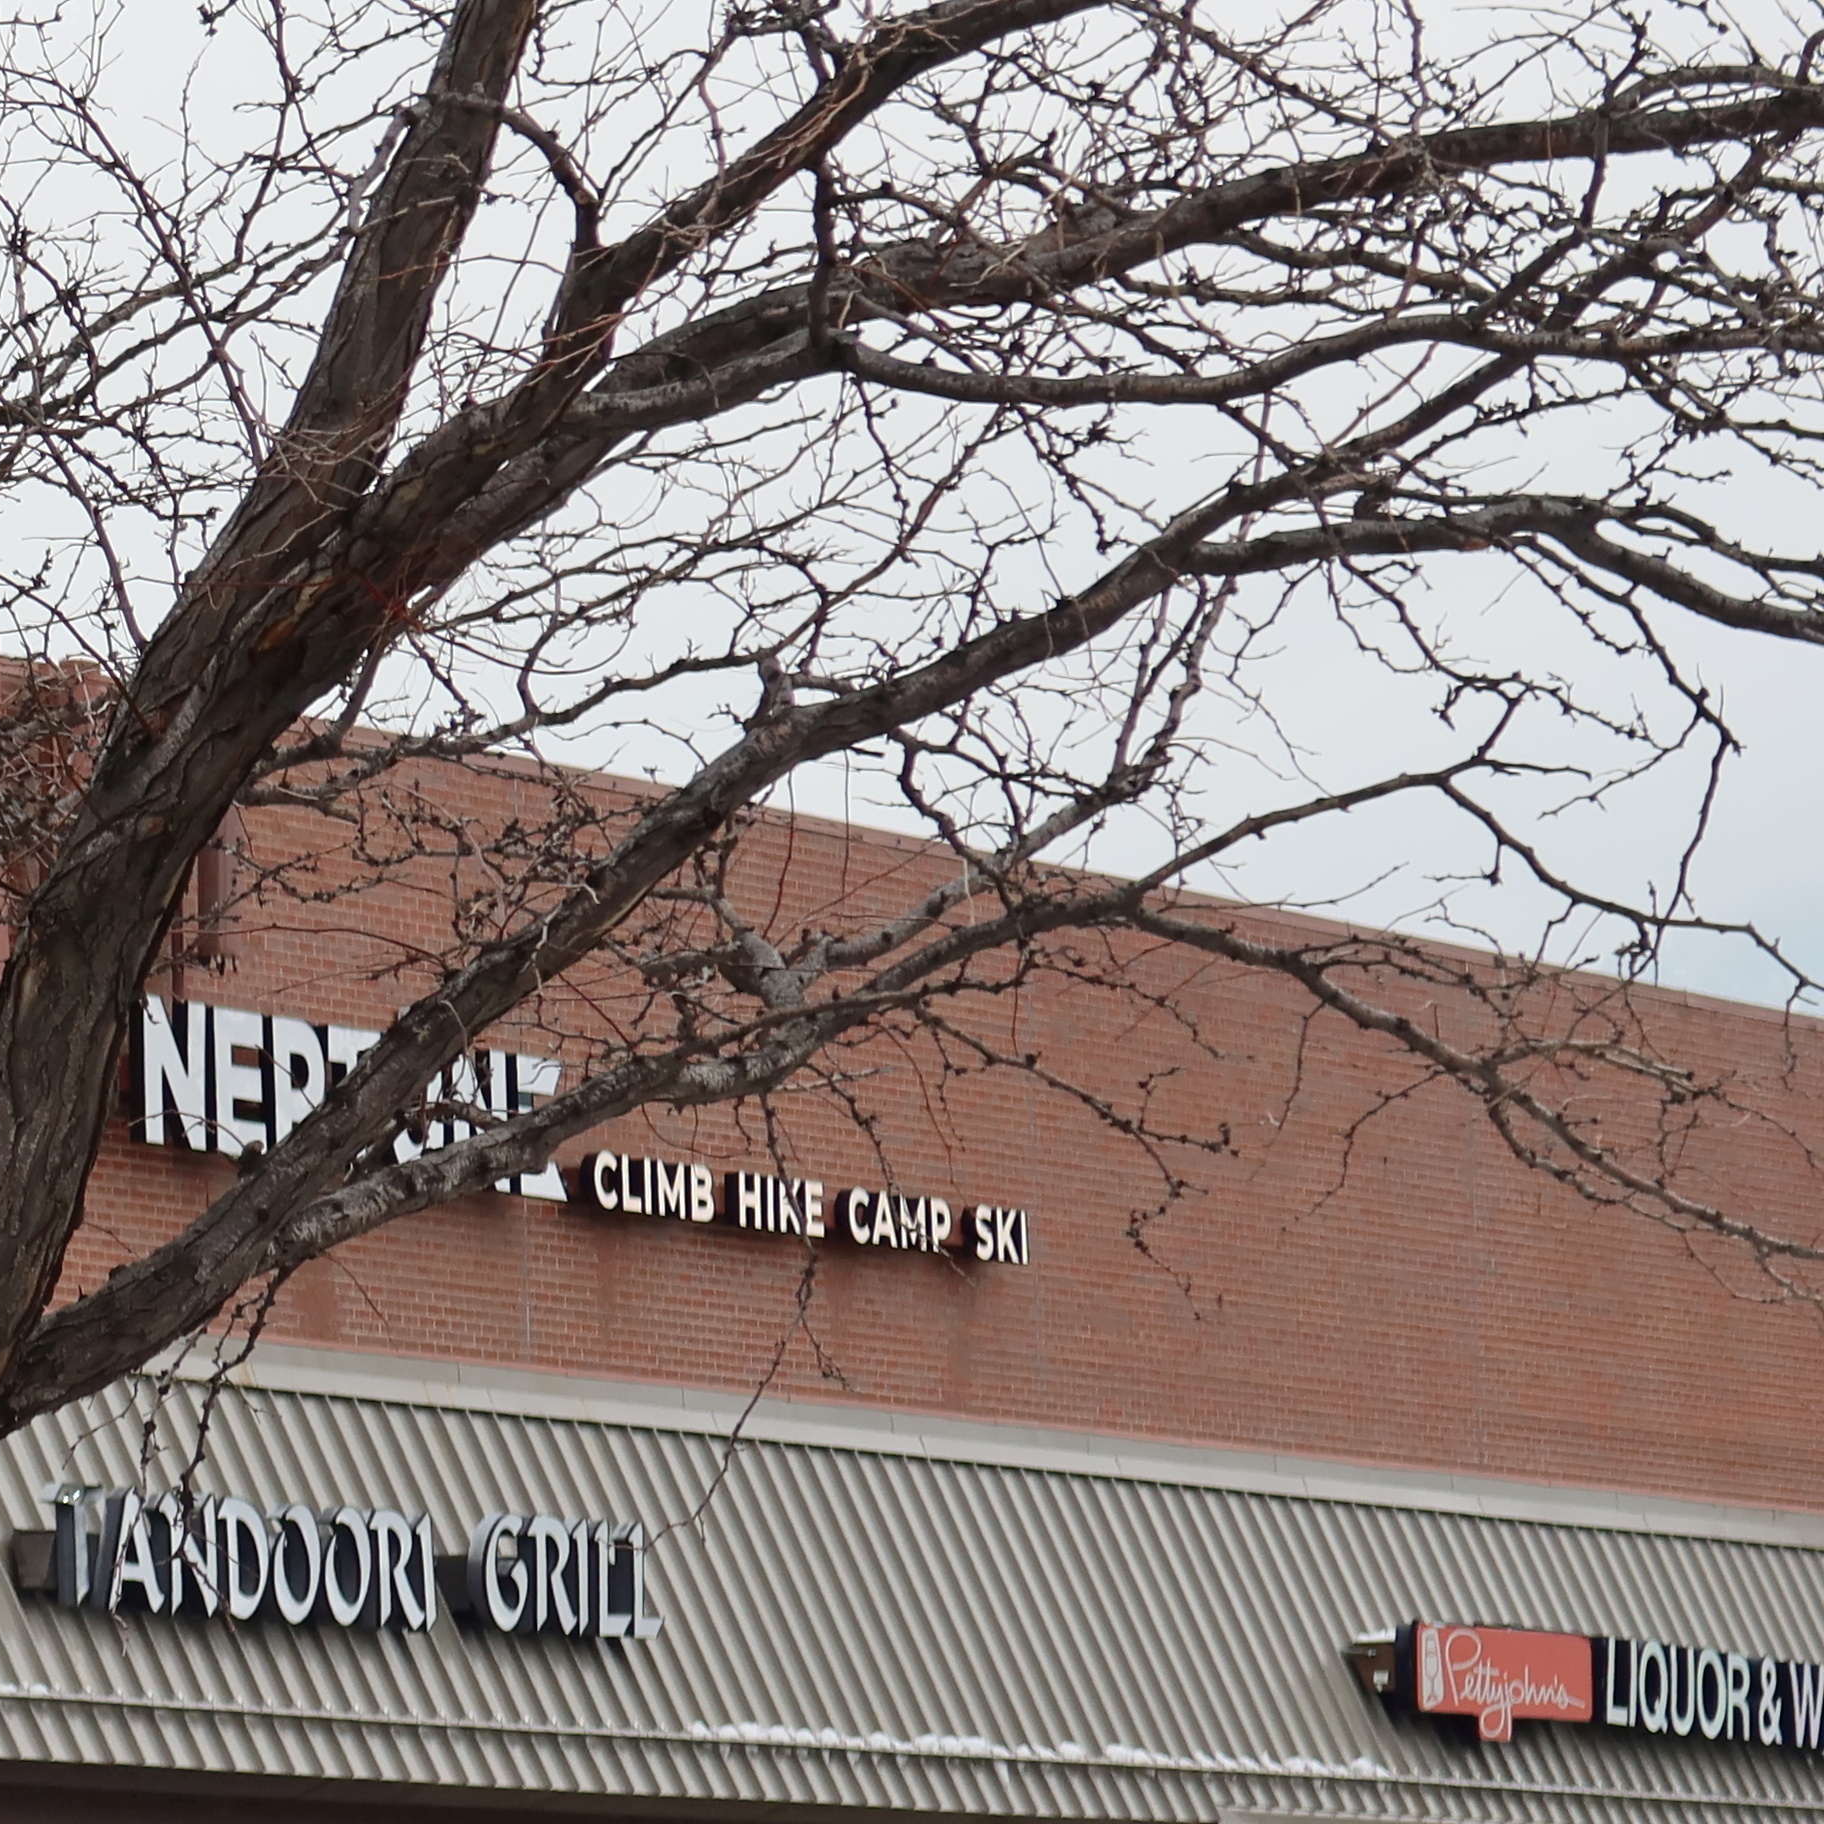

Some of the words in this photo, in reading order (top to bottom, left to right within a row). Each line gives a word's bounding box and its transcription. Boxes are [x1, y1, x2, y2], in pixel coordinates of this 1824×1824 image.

[593, 1149, 716, 1223] CLIMB
[737, 1169, 826, 1239] HIKE
[848, 1185, 952, 1254] CAMP
[975, 1203, 1030, 1266] SKI
[42, 1483, 435, 1633] TANDOORI
[484, 1512, 665, 1640] GRILL
[1445, 1628, 1586, 1742] Pettyjohn's
[1606, 1635, 1751, 1743] LIQUOR
[1758, 1654, 1783, 1747] &
